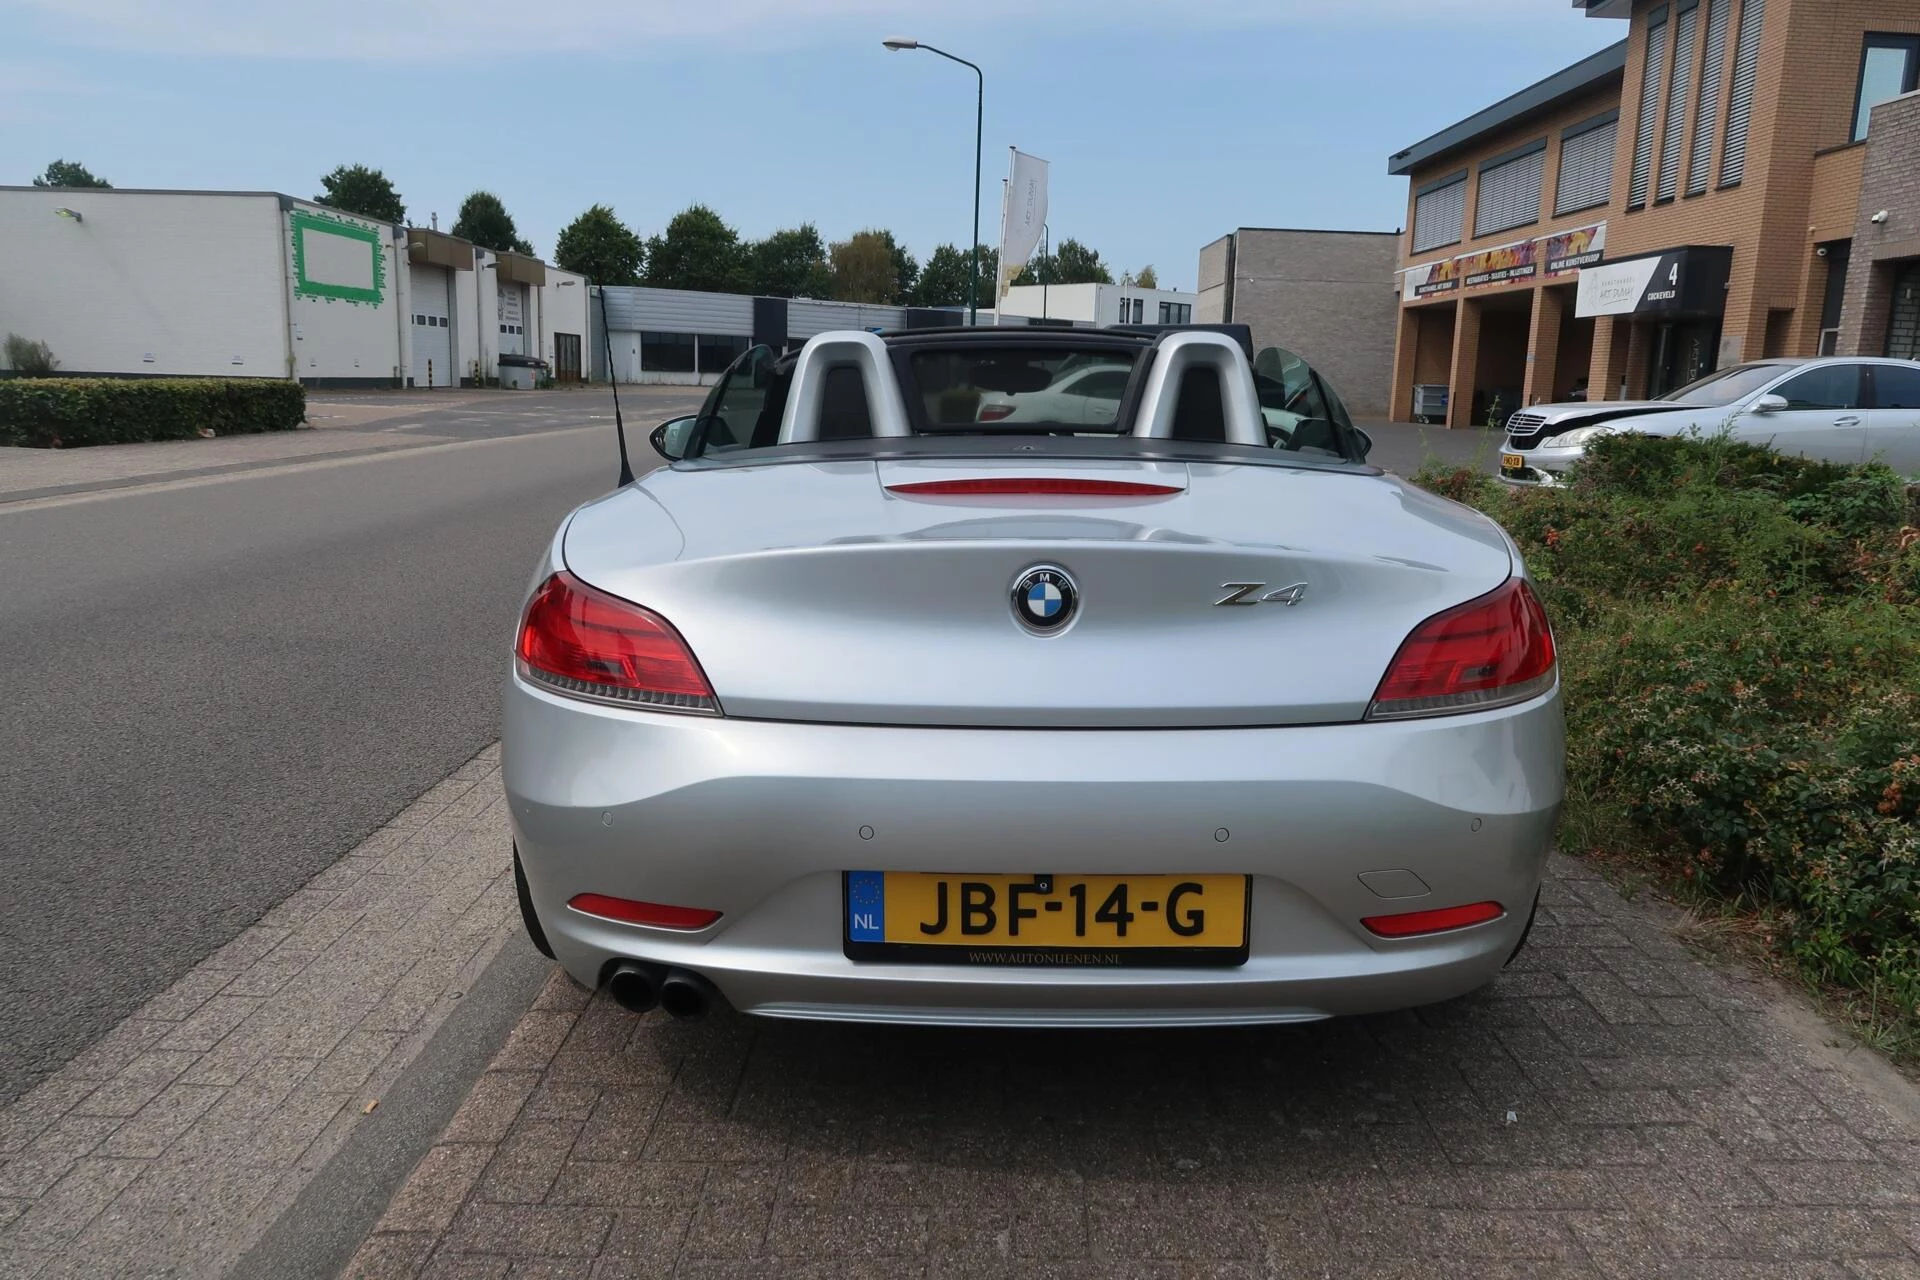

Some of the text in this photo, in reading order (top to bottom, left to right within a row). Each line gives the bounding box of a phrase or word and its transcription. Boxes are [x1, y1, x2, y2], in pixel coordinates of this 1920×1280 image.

[1668, 262, 1679, 286] 4
[1647, 290, 1676, 301] COCKEVELD
[1022, 573, 1069, 592] BMW
[1213, 581, 1308, 607] Z4
[919, 881, 1206, 937] JBF-14-G
[854, 913, 879, 930] NL
[968, 950, 1123, 966] WWW.AUTONUENEN.NL
